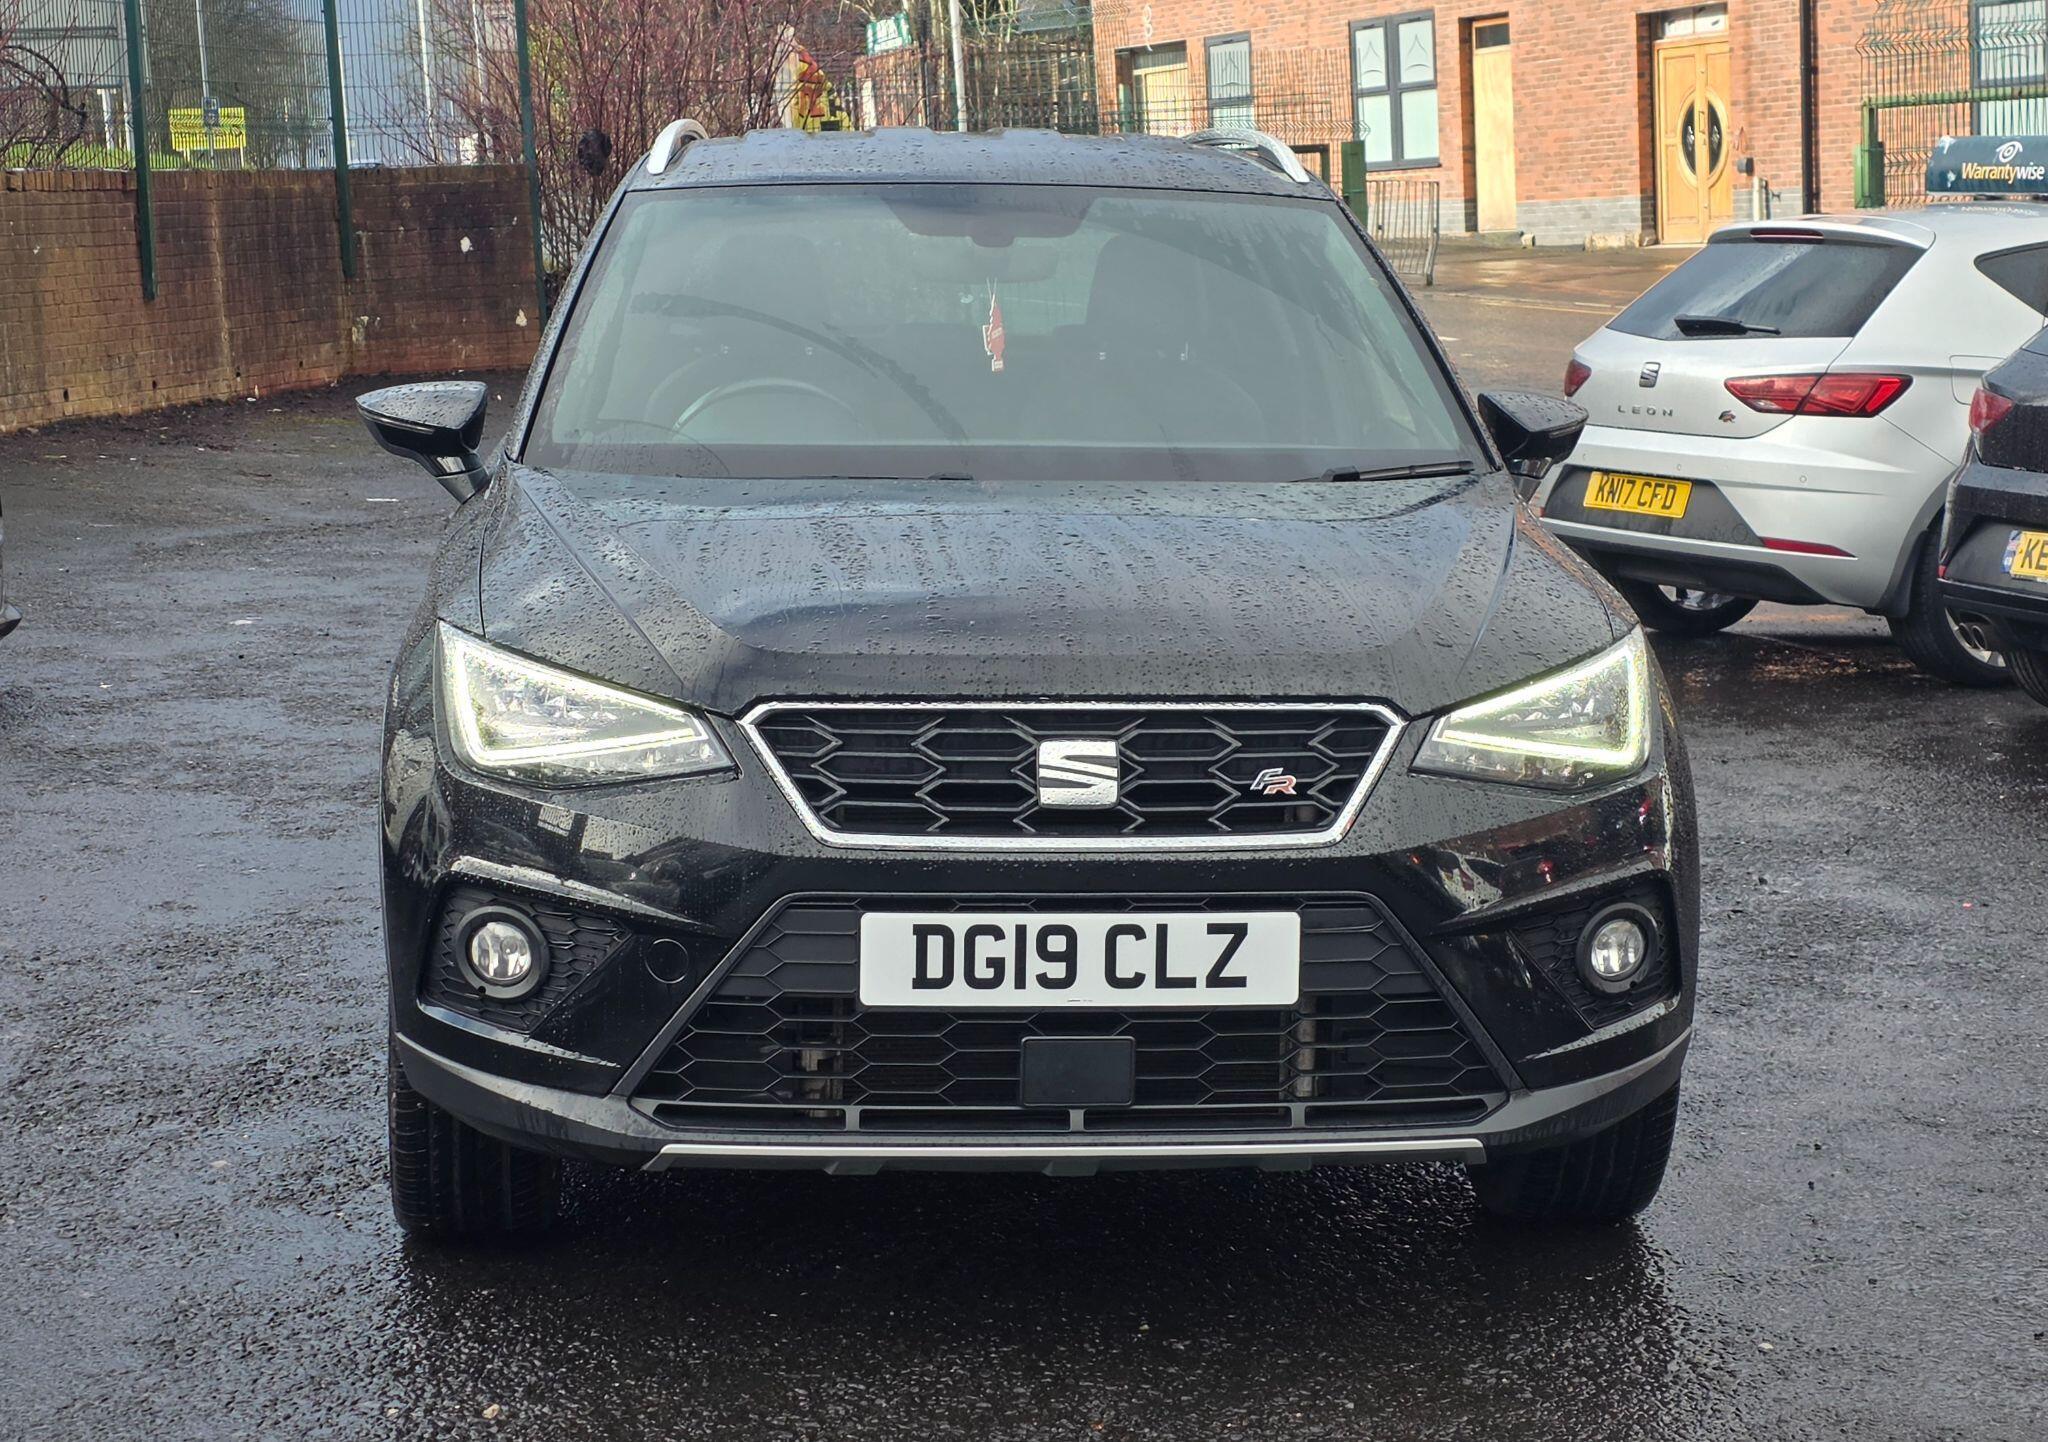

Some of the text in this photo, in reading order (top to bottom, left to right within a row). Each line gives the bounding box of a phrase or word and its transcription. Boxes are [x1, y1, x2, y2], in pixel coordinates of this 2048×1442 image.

[1961, 161, 2046, 184] Warrantywise
[1617, 405, 1673, 417] LEON
[1595, 474, 1677, 511] KN17 CFD
[1250, 767, 1297, 795] FR
[912, 923, 1248, 990] DG19 CLZ
